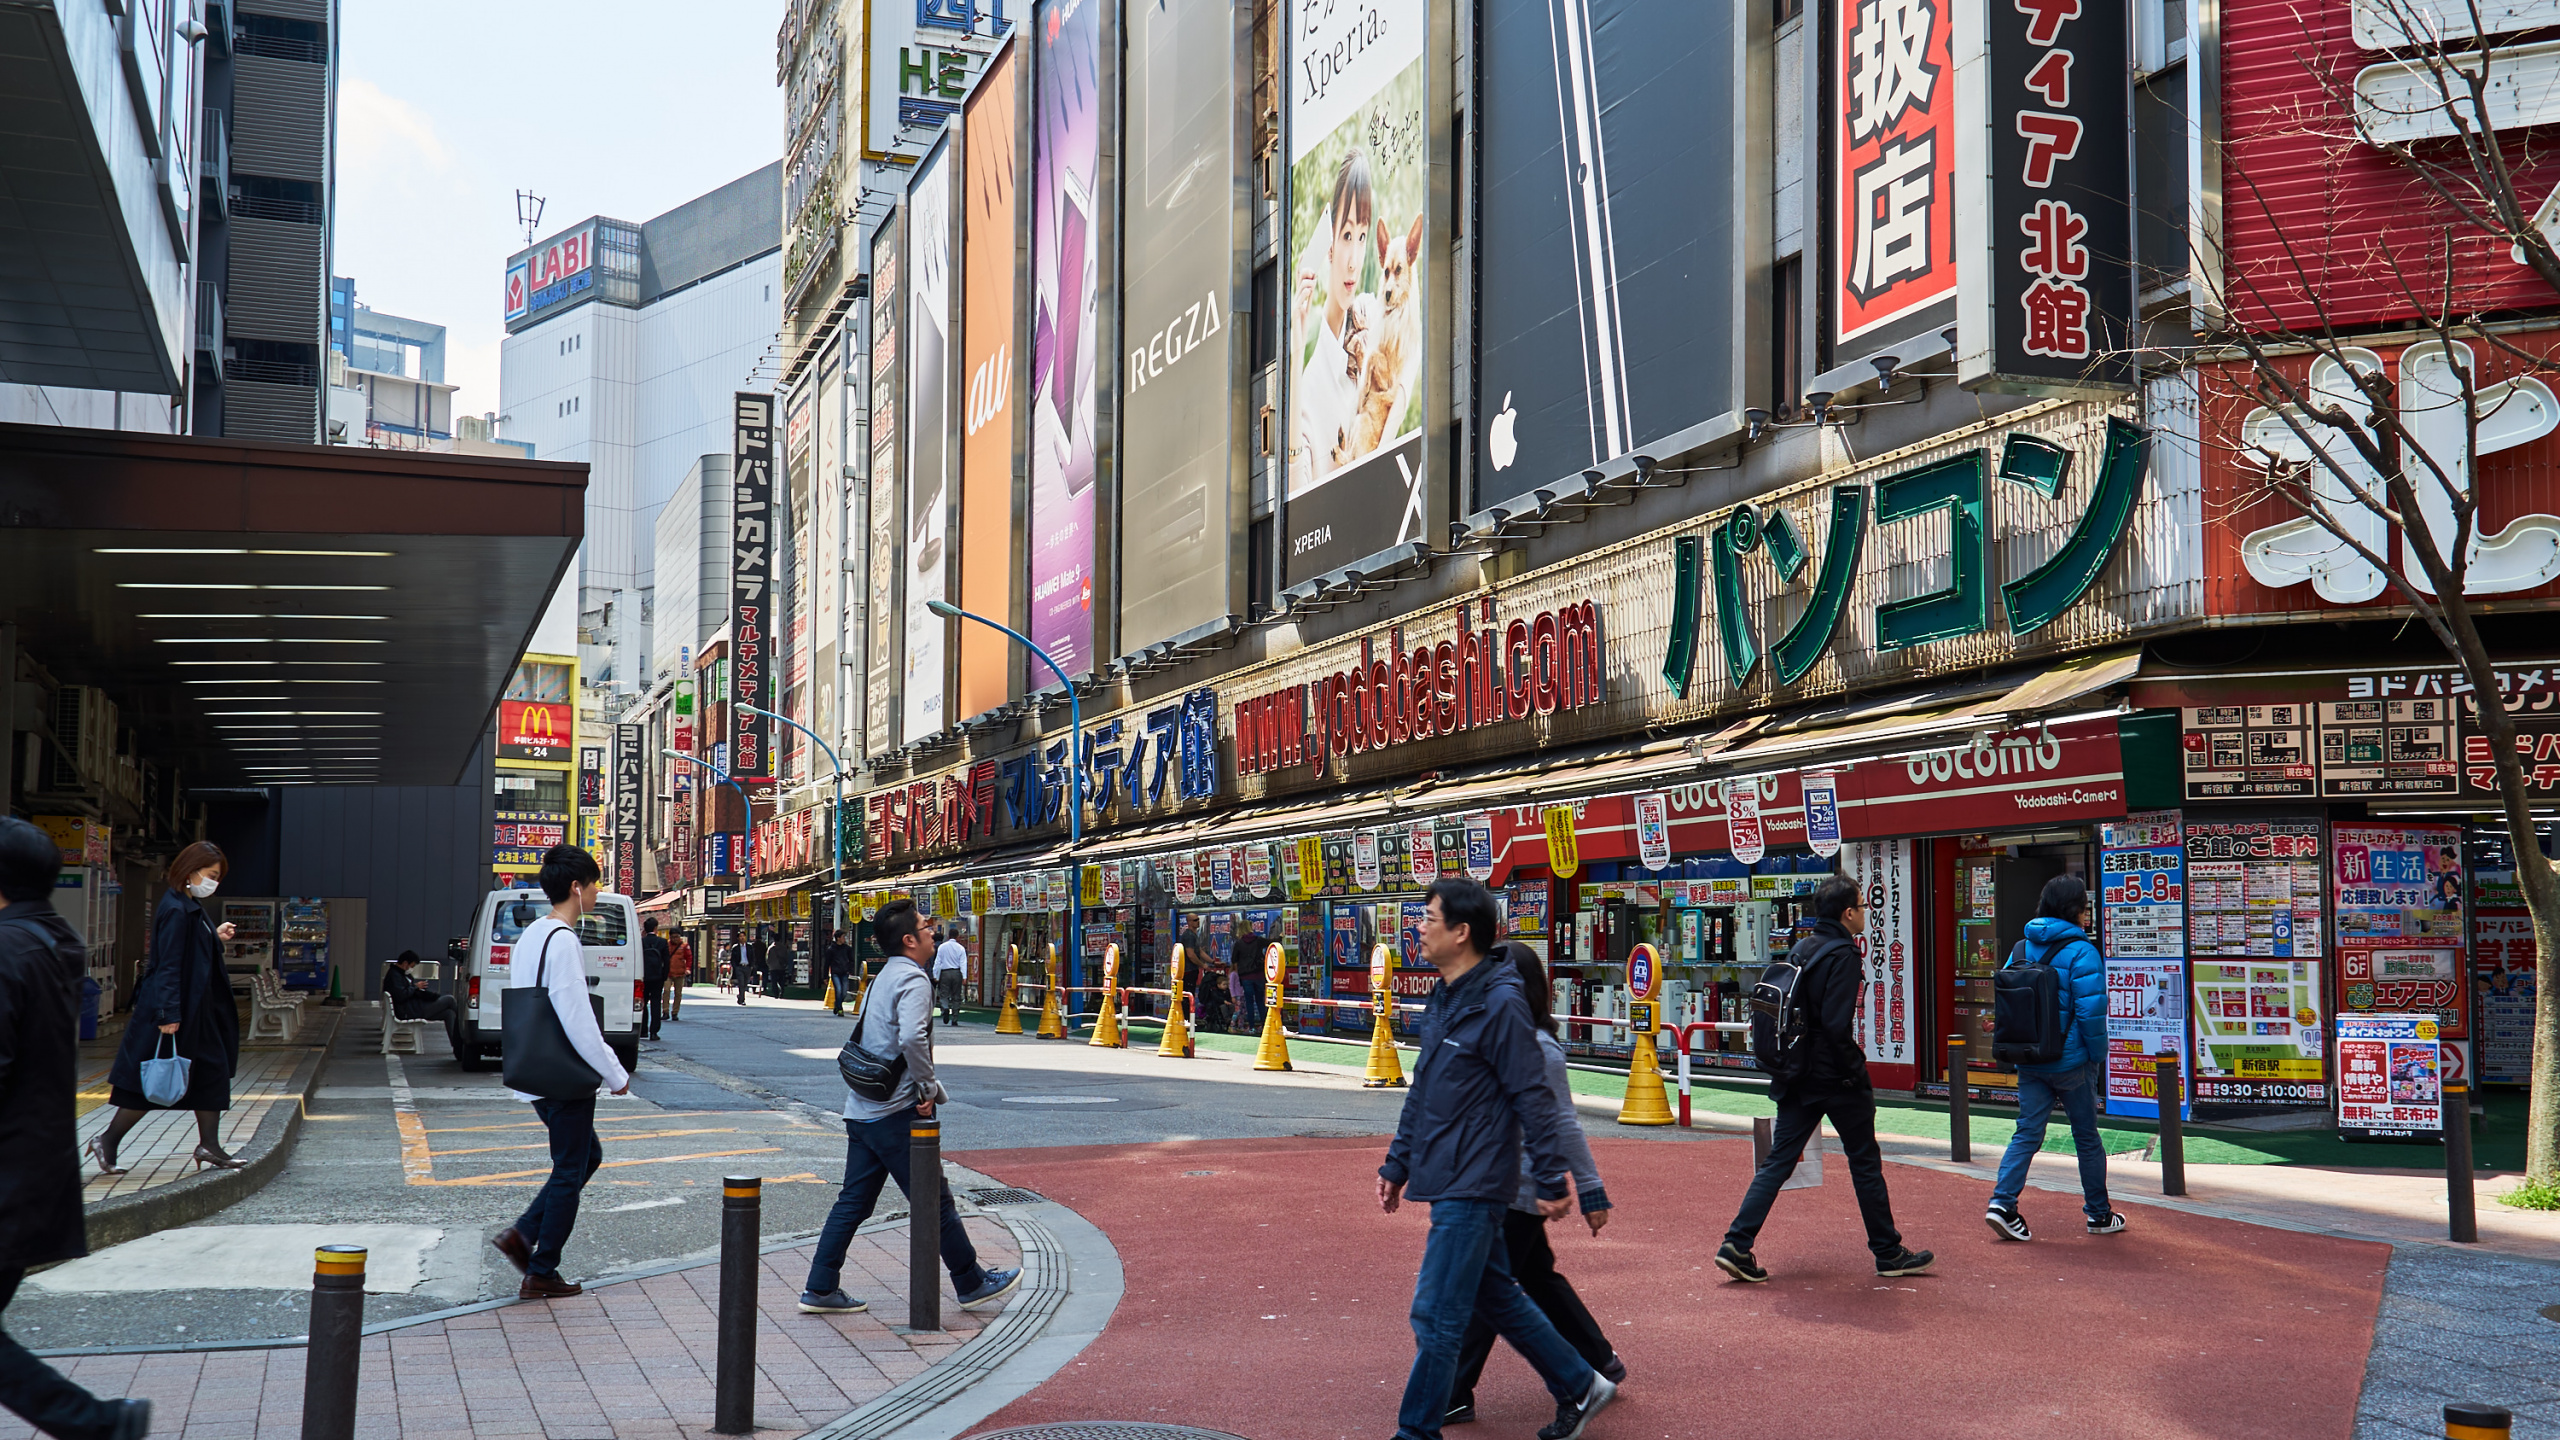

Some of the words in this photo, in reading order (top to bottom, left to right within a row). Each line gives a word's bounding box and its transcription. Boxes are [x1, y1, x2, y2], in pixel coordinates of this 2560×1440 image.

[900, 47, 988, 97] HE
[531, 231, 587, 292] LABI
[1131, 290, 1221, 393] REGZA
[968, 343, 1011, 436] au
[735, 400, 768, 600] ヨドバシカメラ
[1294, 524, 1332, 556] XPERIA
[1662, 413, 2152, 700] パソコン
[1034, 574, 1060, 603] HUAWEI
[1075, 563, 1081, 582] 9
[1235, 596, 1604, 781] www.yodobashi.com
[533, 747, 548, 757] 24
[2286, 767, 2313, 777] 現在地
[2427, 763, 2456, 773] 現在地
[619, 725, 638, 840] ヨドバシカメラ
[2201, 784, 2233, 795] 新宿駅
[2240, 784, 2253, 792] JR
[2255, 783, 2301, 792] 新宿駅西口
[2339, 781, 2372, 791] 新宿駅
[2379, 781, 2392, 789] JR
[2395, 780, 2442, 789] 新宿駅西口
[2015, 788, 2117, 808] Yodobashi-Camera
[869, 759, 997, 862] ヨドバシカメラ
[1730, 801, 1755, 819] 8%
[1734, 828, 1758, 846] 5%
[2186, 823, 2269, 836] ヨドバシカメラ
[2187, 835, 2319, 859] 各館のご案内
[2103, 851, 2179, 873] 生活家電売場は
[2107, 972, 2156, 987] まとめ買い
[2109, 990, 2143, 1017] 割引
[2375, 981, 2458, 1007] エアコン
[2241, 1060, 2279, 1071] 新宿駅
[2350, 1060, 2377, 1072] 最新
[2139, 1076, 2158, 1097] 10
[2220, 1083, 2251, 1096] 9:30
[2268, 1084, 2306, 1098] 10:00
[2341, 1085, 2387, 1095] サービスの
[2342, 1105, 2439, 1122] 無料にて配布中
[2368, 1129, 2413, 1137] ヨドバシカメラ
